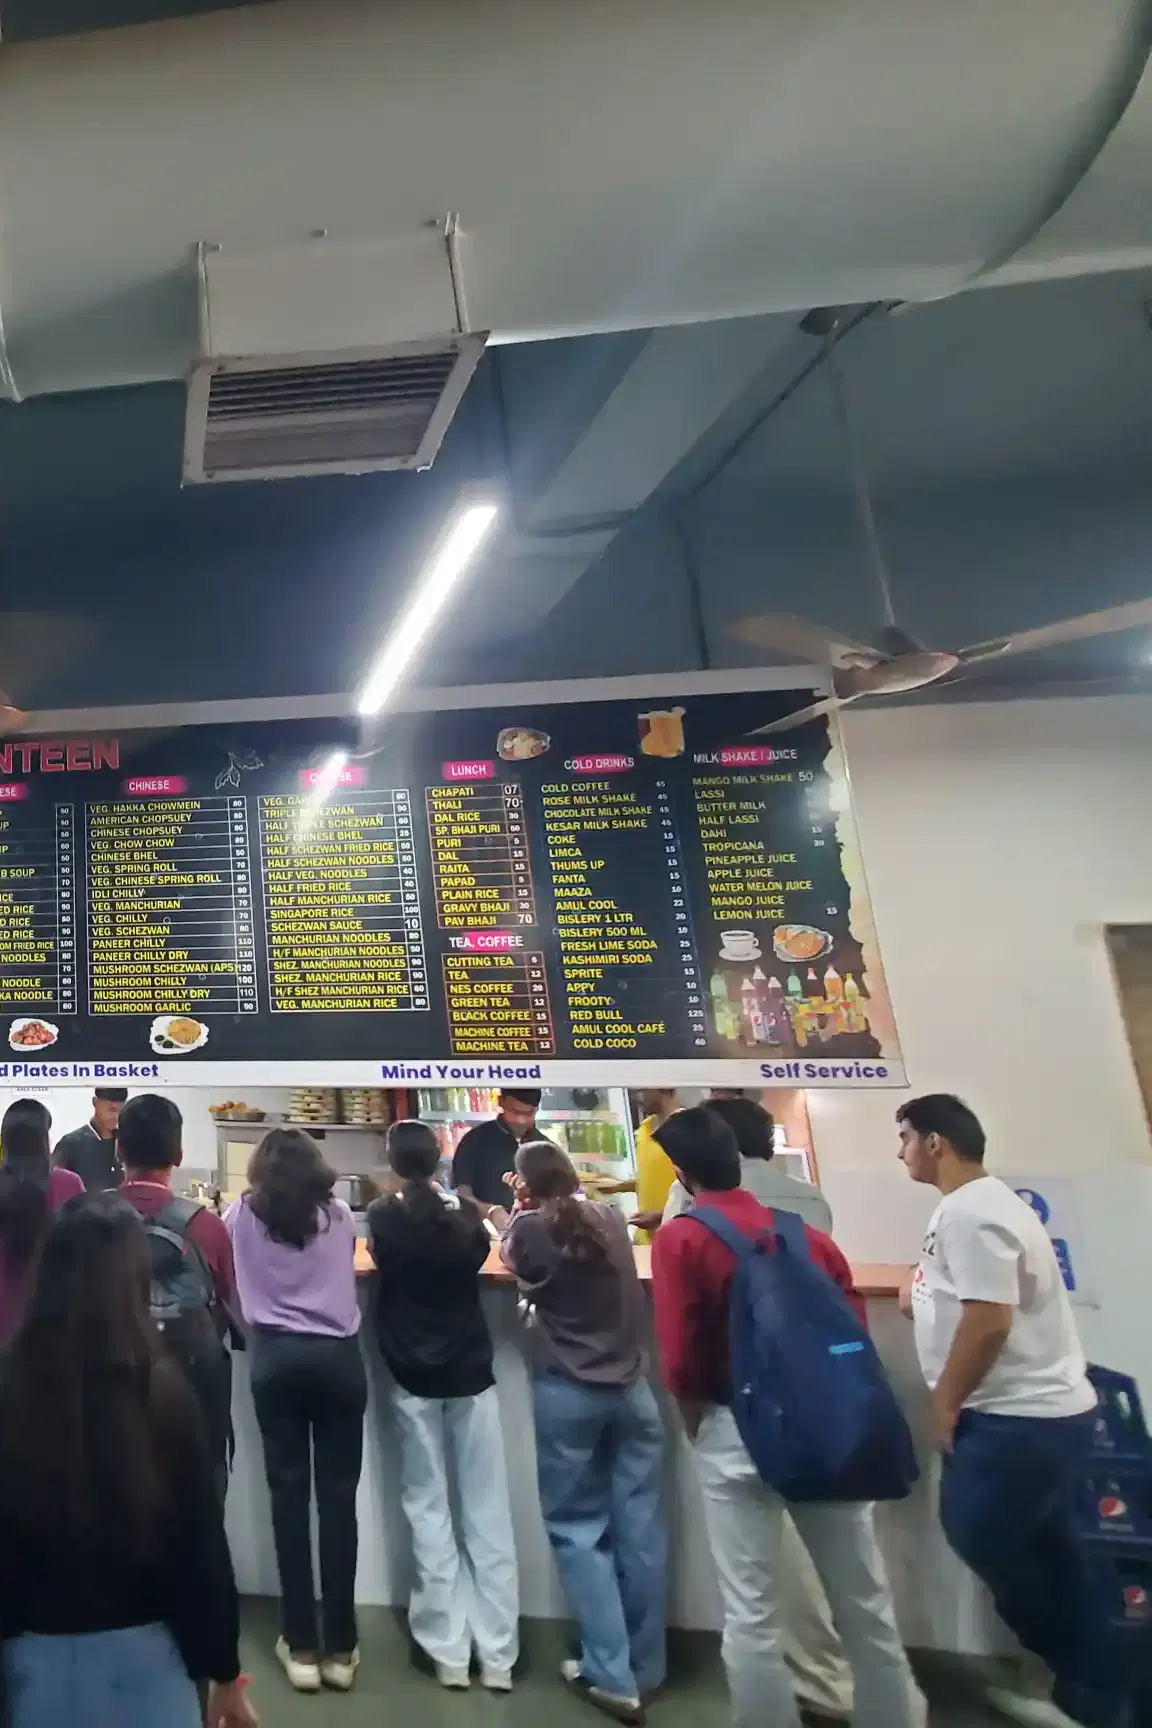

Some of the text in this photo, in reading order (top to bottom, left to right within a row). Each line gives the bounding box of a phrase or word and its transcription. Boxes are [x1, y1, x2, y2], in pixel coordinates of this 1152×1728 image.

[694, 753, 719, 763] MILK
[721, 751, 757, 762] SHAKE
[768, 749, 797, 760] JUICE
[564, 757, 634, 770] COLD DRINKS
[452, 764, 486, 776] LUNCH
[129, 780, 169, 791] CHINESE
[432, 784, 517, 798] CHAPATI 07
[90, 801, 200, 813] VEG. HAKKA CHOWMEIN
[433, 798, 520, 810] THALI 70
[90, 813, 192, 825] AMERICAN CHOPSUEY
[434, 812, 480, 822] DAL RICE
[701, 829, 726, 838] DAHI
[91, 838, 174, 849] VEG. CHOW CHOW
[436, 838, 461, 848] PURI
[548, 834, 576, 845] COKE
[703, 841, 764, 852] TROPICANA
[91, 851, 157, 862] CHINESE BHEL
[549, 847, 581, 858] LIMCA
[440, 863, 469, 874] RAITA
[551, 859, 604, 871] THUMS UP
[552, 873, 585, 884] FANTA
[708, 868, 773, 879] APPLE JUICE
[441, 876, 475, 887] PAPAD
[710, 881, 812, 892] WATER MELON JUICE
[92, 888, 145, 898] IDLI CHILLY
[442, 889, 499, 900] PLAIN RICE
[554, 886, 592, 897] MAAZA
[12, 905, 34, 914] RICE
[92, 900, 180, 911] VEG. MANCHURIAN
[556, 899, 617, 910] AMUL COOL
[271, 909, 328, 919] SINGAPORE
[330, 908, 354, 918] RICE
[714, 909, 784, 920] LEMON JUICE
[272, 919, 418, 931] SCHEZWAN SAUCE 10
[445, 914, 532, 927] PAV BHAJI 70
[272, 933, 390, 944] MANCHURIAN NOODLES
[449, 936, 524, 948] TEA, COFFEE
[93, 951, 188, 961] PANEER CHILLY DRY
[447, 956, 513, 967] CUTTING TEA
[449, 970, 468, 980] TEA
[564, 968, 602, 979] SPRITE
[566, 982, 596, 992] APPY
[276, 999, 397, 1009] VEG. MANCHURIAN RICE
[568, 996, 611, 1006] FROOTY
[94, 1002, 191, 1012] MUSHROOM GARLIC
[570, 1009, 623, 1020] RED BULL
[456, 1040, 528, 1051] MACHINE TEA
[574, 1038, 636, 1049] COLD COCO
[13, 1064, 68, 1077] Plates
[73, 1065, 90, 1077] In
[94, 1064, 158, 1077] Basket
[382, 1064, 541, 1079] Mind Your Head
[760, 1062, 888, 1078] Self Service
